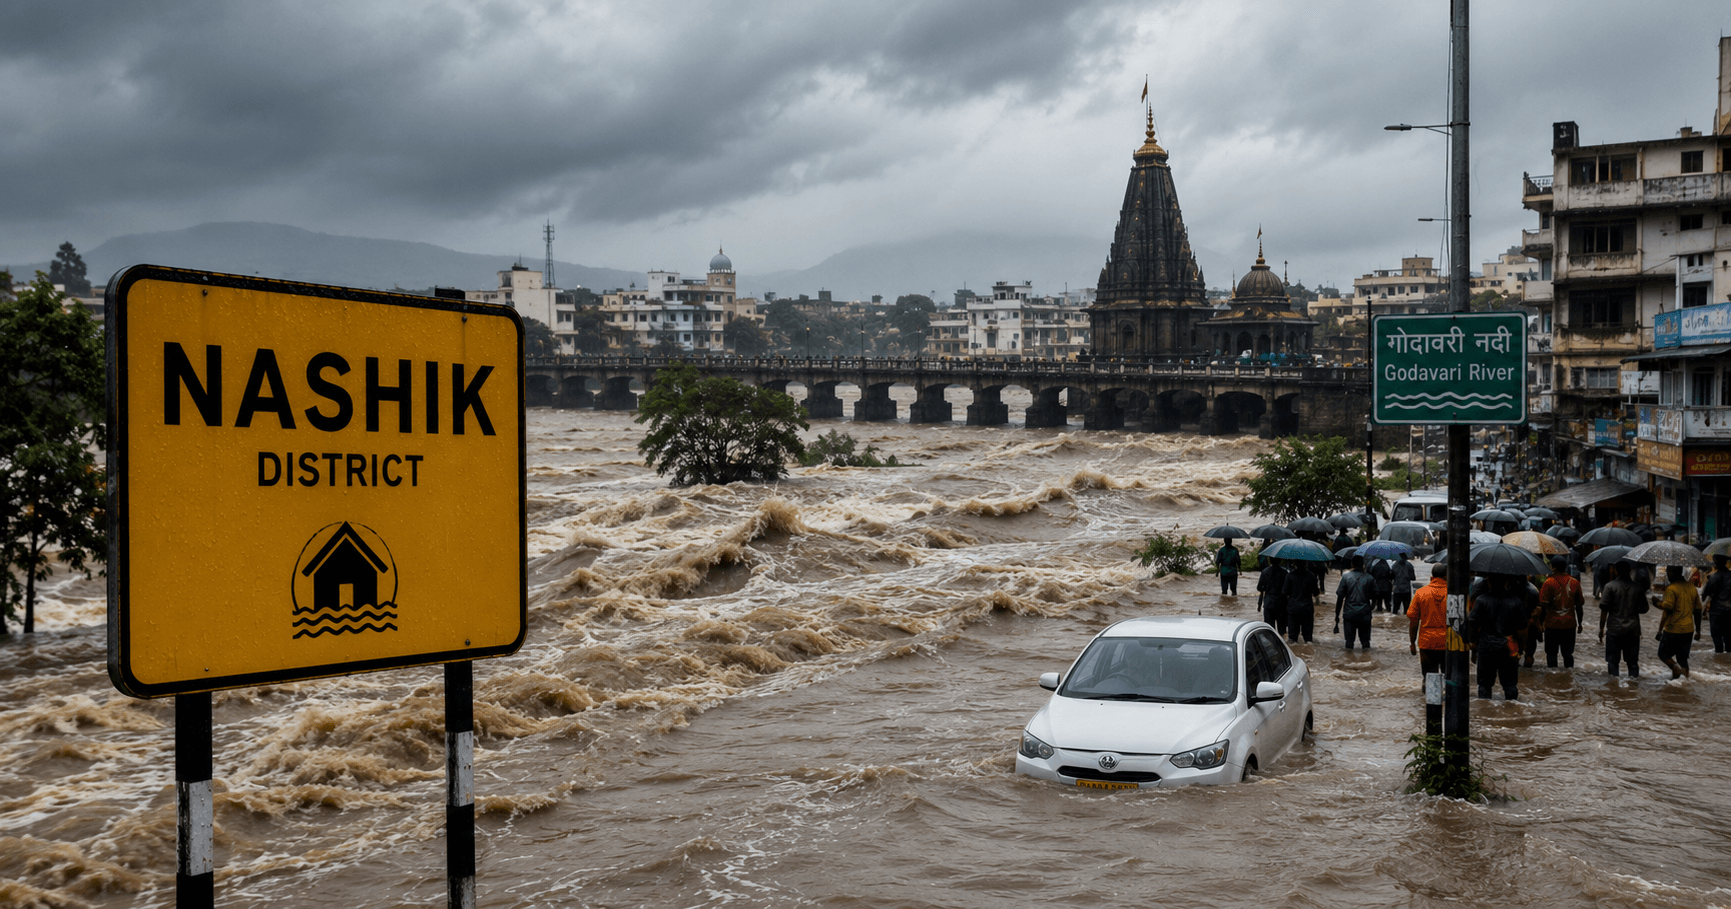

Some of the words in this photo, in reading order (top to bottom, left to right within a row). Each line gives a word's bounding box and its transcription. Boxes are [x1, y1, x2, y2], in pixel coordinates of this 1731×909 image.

[1386, 326, 1466, 355] गोदावरी
[1473, 325, 1513, 354] नदी
[163, 341, 497, 436] NASHIK
[1384, 363, 1462, 382] Godavari
[1469, 363, 1515, 381] River
[257, 451, 424, 488] DISTRICT
